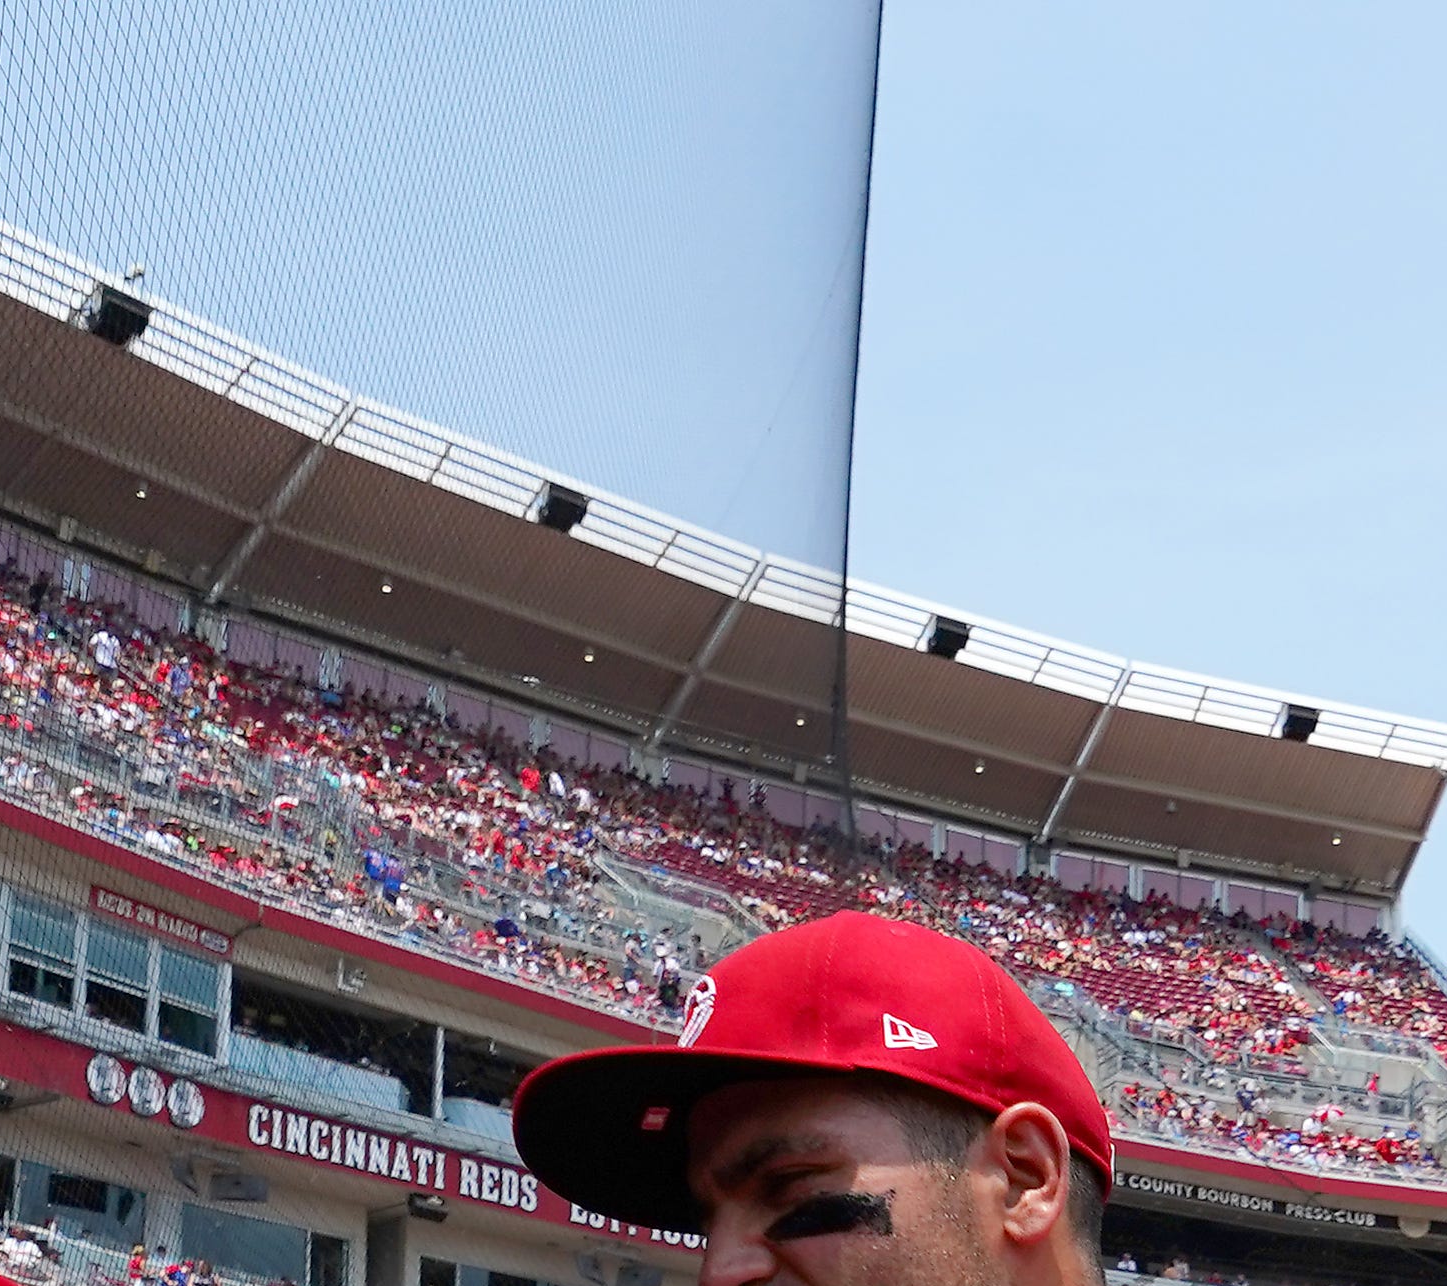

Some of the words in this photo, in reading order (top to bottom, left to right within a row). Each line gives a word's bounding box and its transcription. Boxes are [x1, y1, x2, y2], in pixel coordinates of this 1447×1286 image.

[247, 1102, 446, 1191] CINCINNATI
[459, 1157, 538, 1212] REDS
[1128, 1173, 1194, 1200] COUNTY
[1333, 1209, 1376, 1227] CLUB
